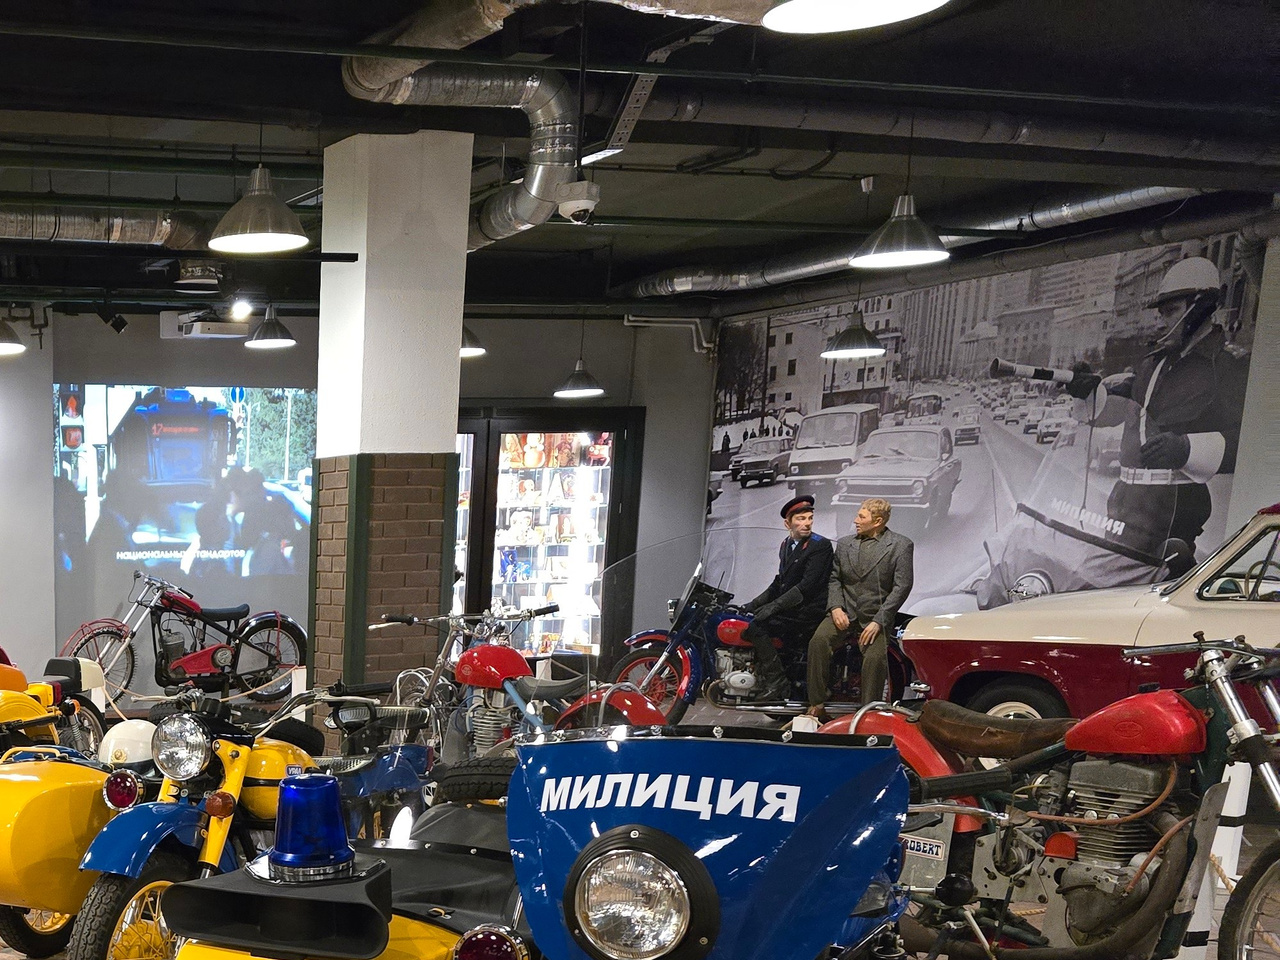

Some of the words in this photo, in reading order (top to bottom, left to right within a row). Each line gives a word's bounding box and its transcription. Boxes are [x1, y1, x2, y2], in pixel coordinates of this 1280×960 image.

[1051, 499, 1126, 536] МИЛИЦИЯ
[195, 549, 246, 559] тандартов
[540, 773, 801, 823] МИЛИЦИЯ
